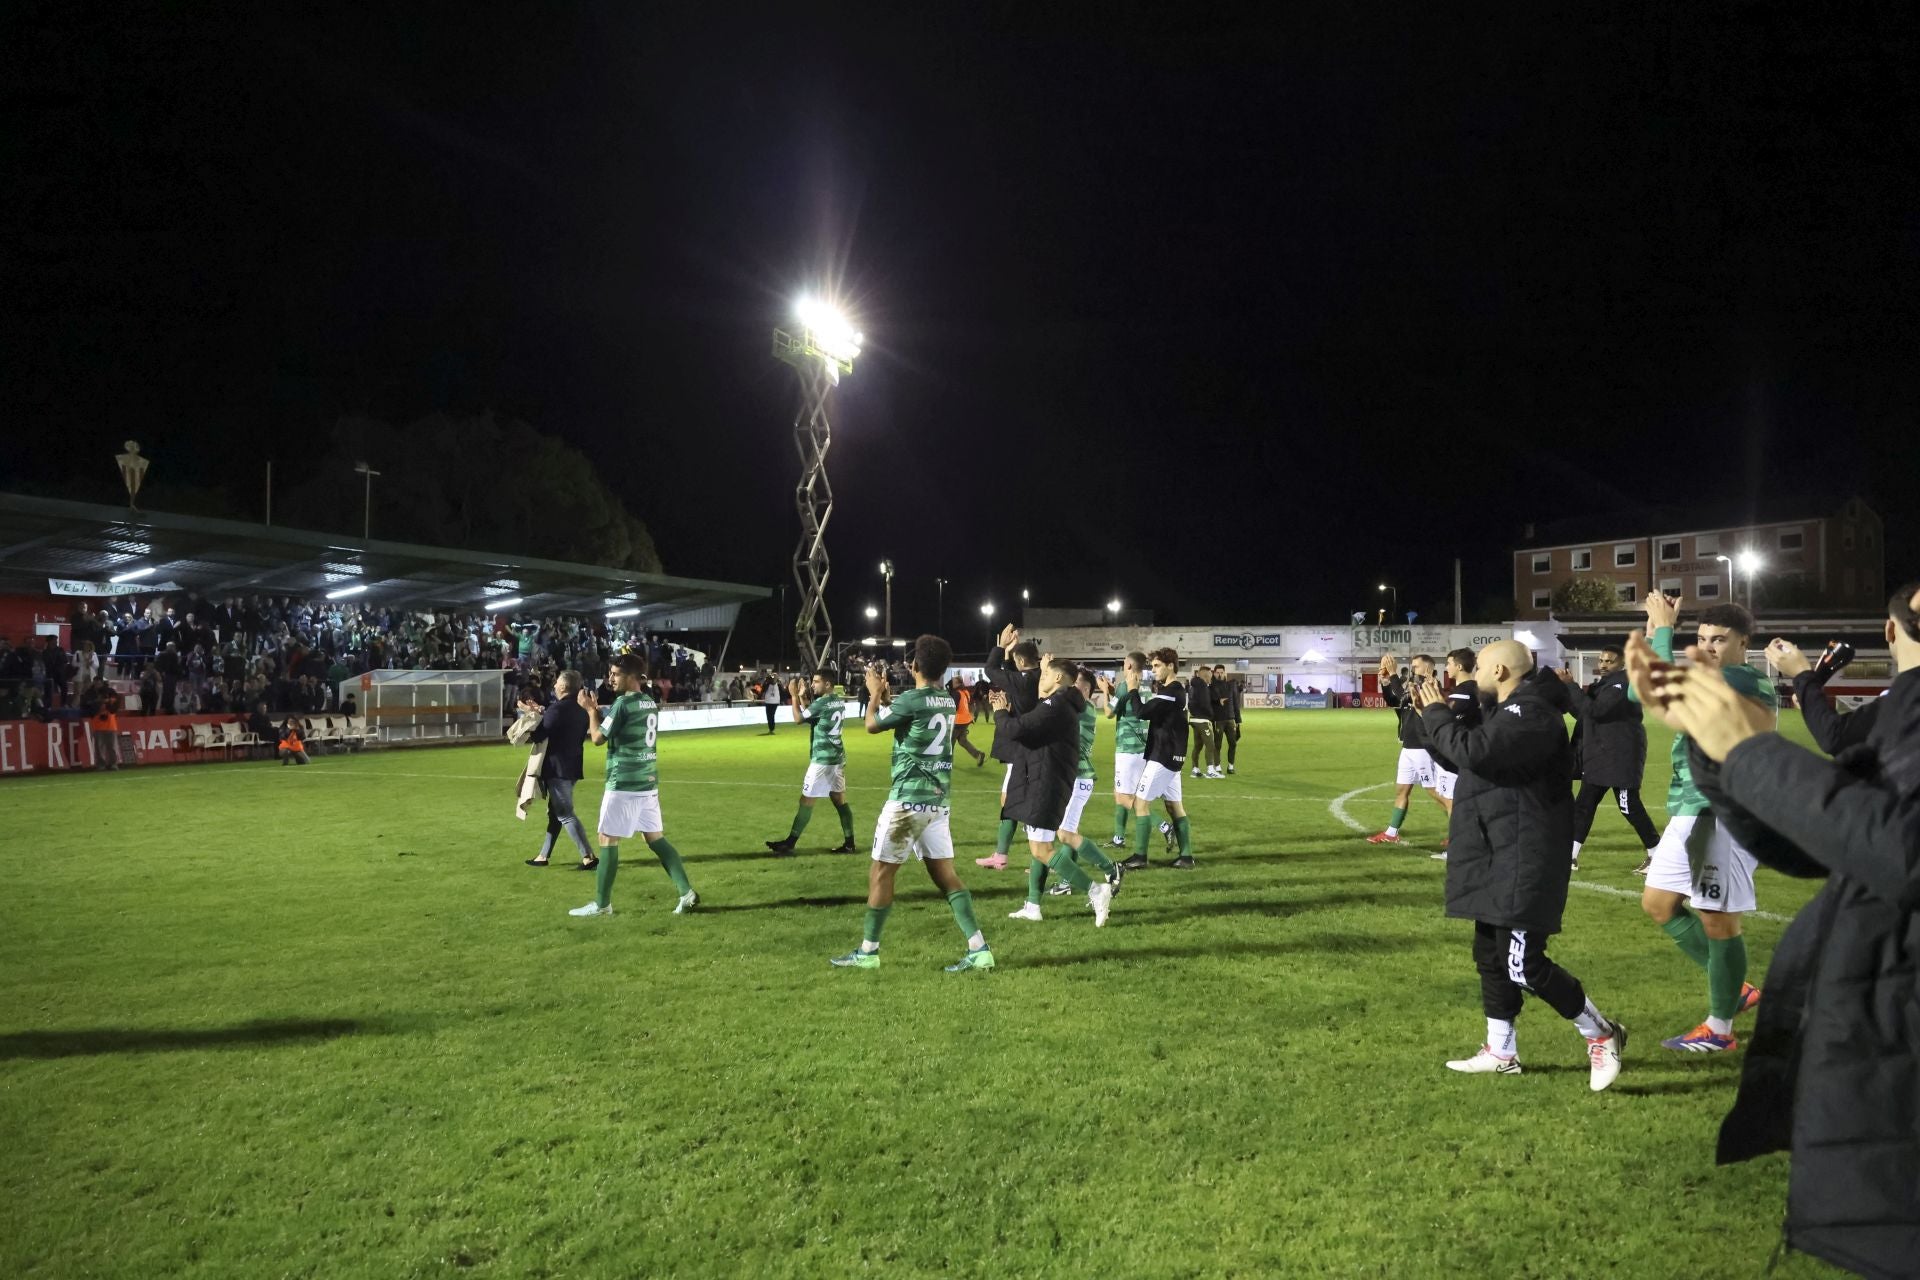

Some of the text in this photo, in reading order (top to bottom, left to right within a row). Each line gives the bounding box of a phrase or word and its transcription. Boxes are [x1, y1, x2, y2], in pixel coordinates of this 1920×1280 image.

[1215, 636, 1279, 645] Reny Picot
[1373, 629, 1411, 644] SOMO
[645, 713, 657, 748] 8
[1699, 882, 1721, 900] 18
